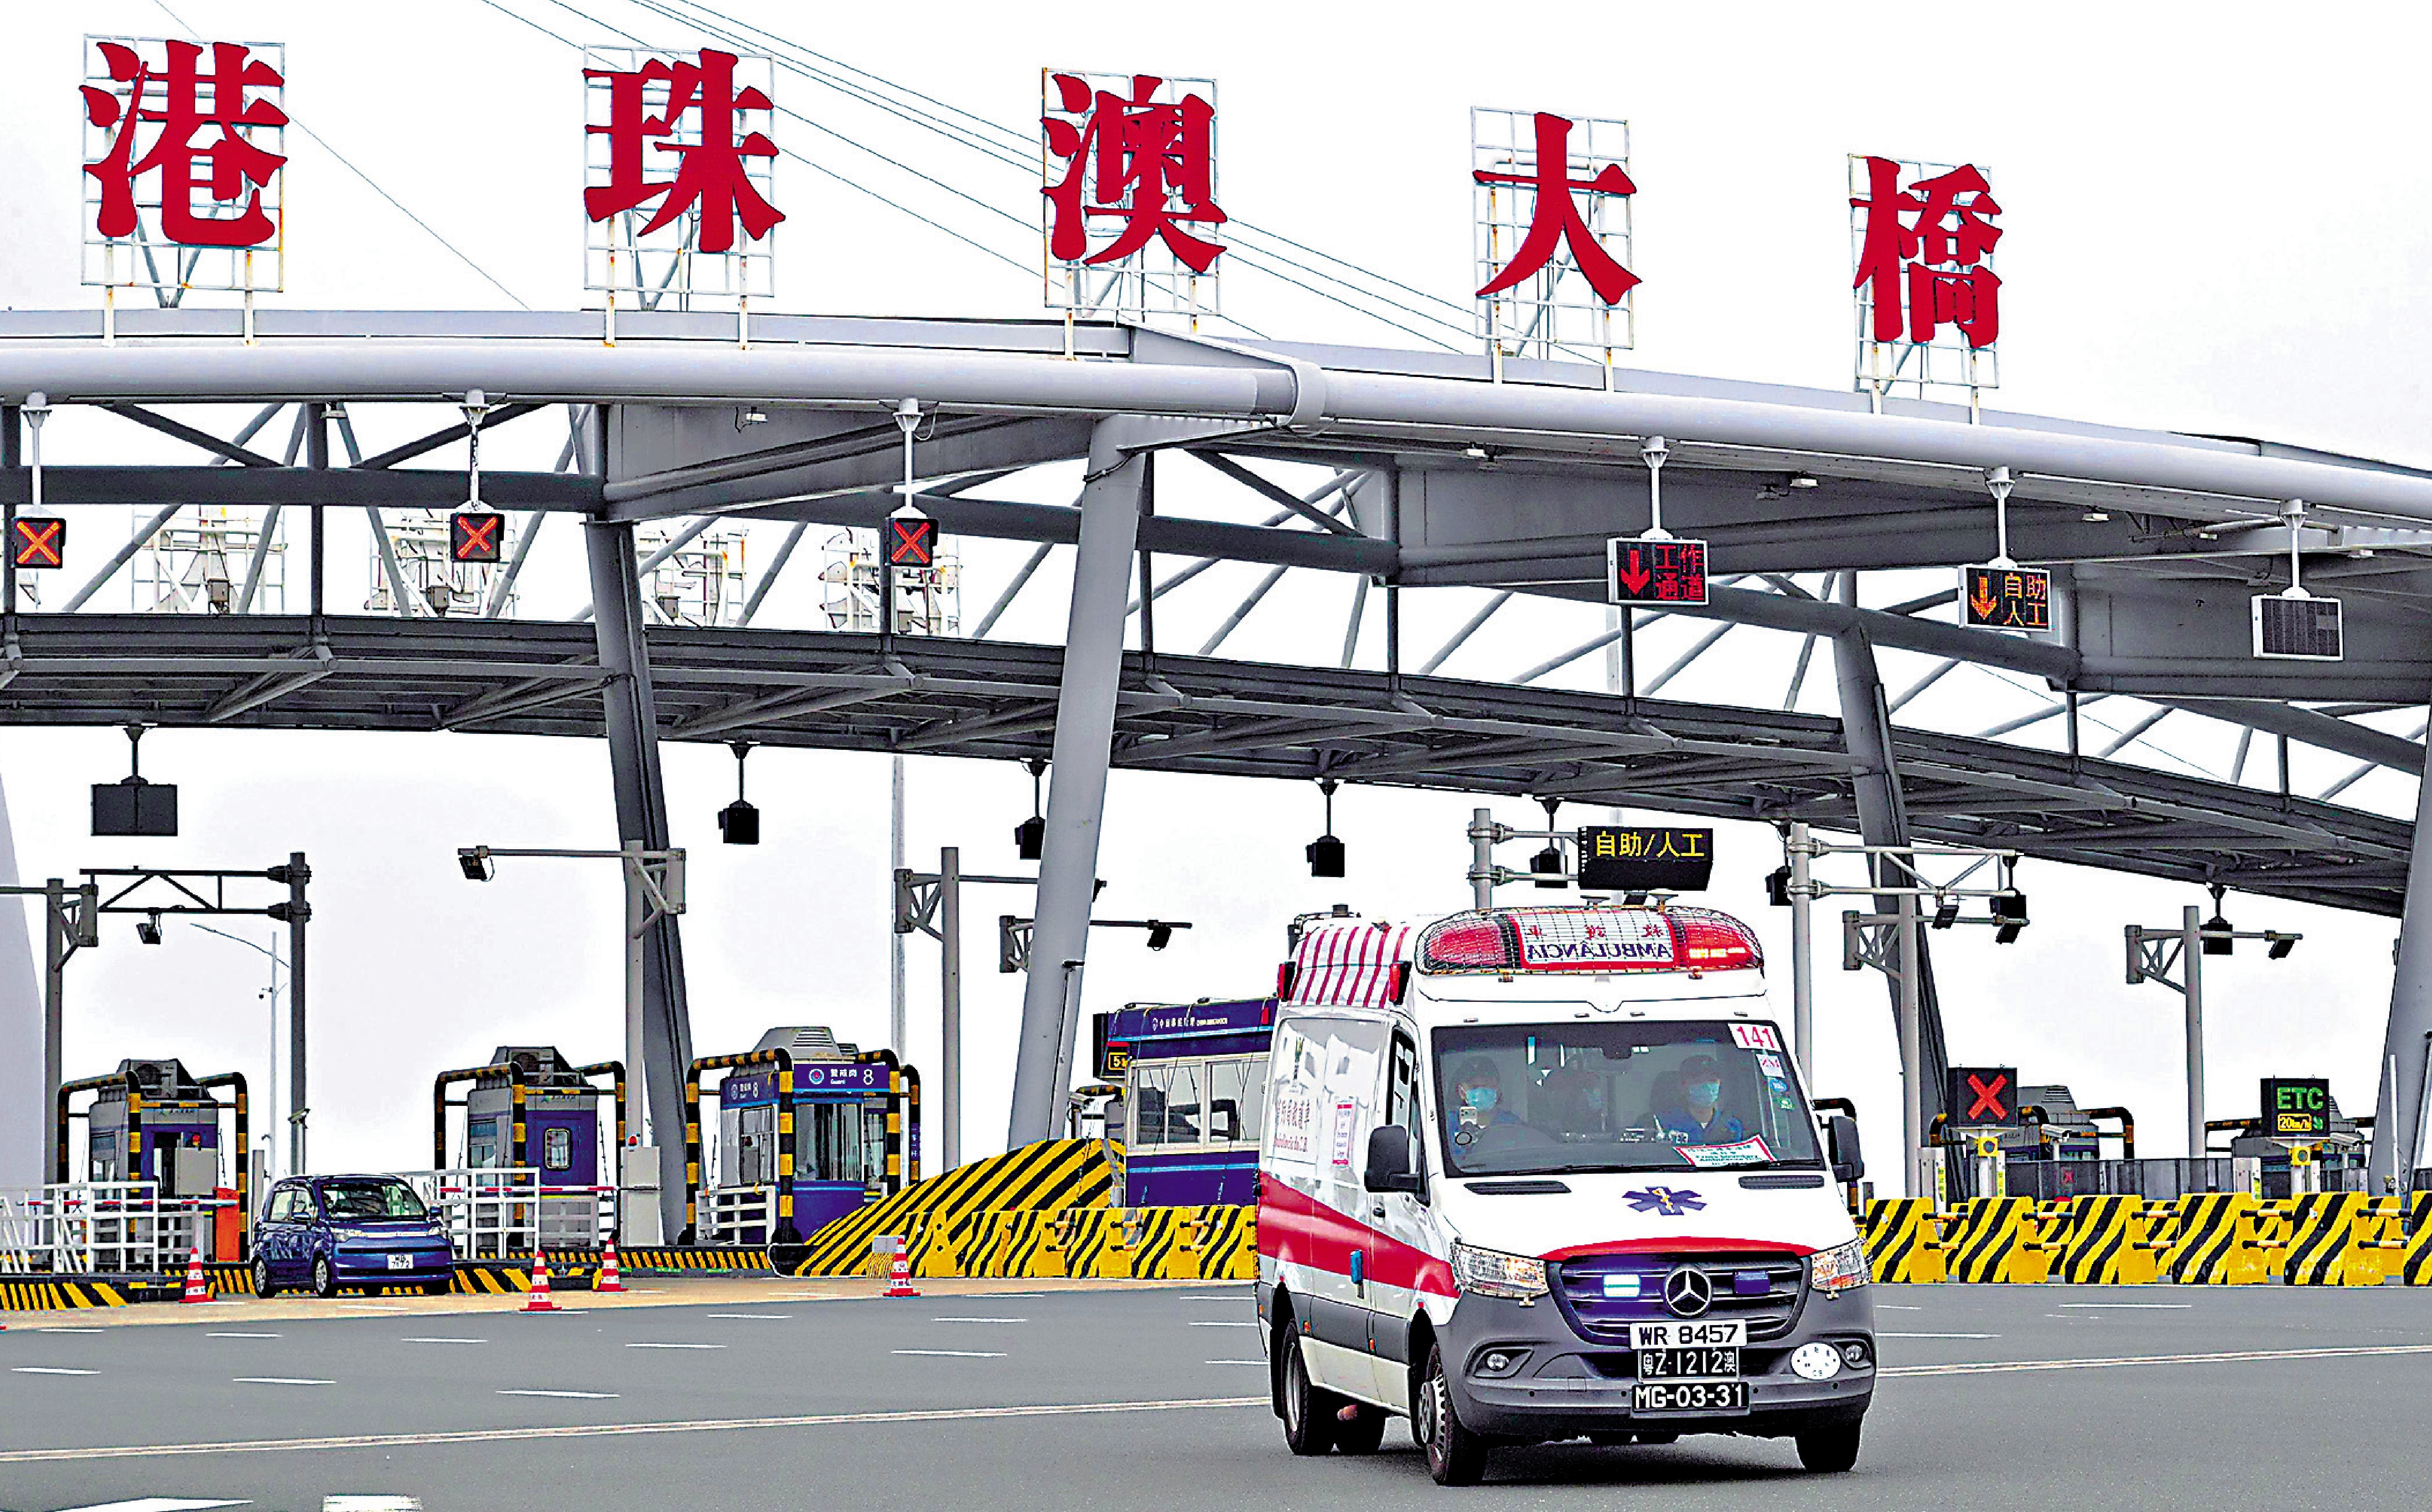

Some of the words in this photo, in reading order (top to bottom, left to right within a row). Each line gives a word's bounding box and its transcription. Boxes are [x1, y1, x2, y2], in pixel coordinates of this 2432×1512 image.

[80, 39, 2004, 350] 港珠澳大橋
[1655, 544, 1704, 573] 工作
[1654, 573, 1704, 600] 通道
[2005, 572, 2046, 600] 自助
[2003, 600, 2048, 627] 人工
[1596, 831, 1705, 858] 自助/人工
[1736, 1026, 1775, 1048] 141
[863, 1068, 874, 1085] 8
[2277, 1087, 2323, 1110] ETC
[1639, 1327, 1668, 1346] WR
[1678, 1324, 1738, 1344] 8457
[1635, 1384, 1742, 1409] MG-03-31
